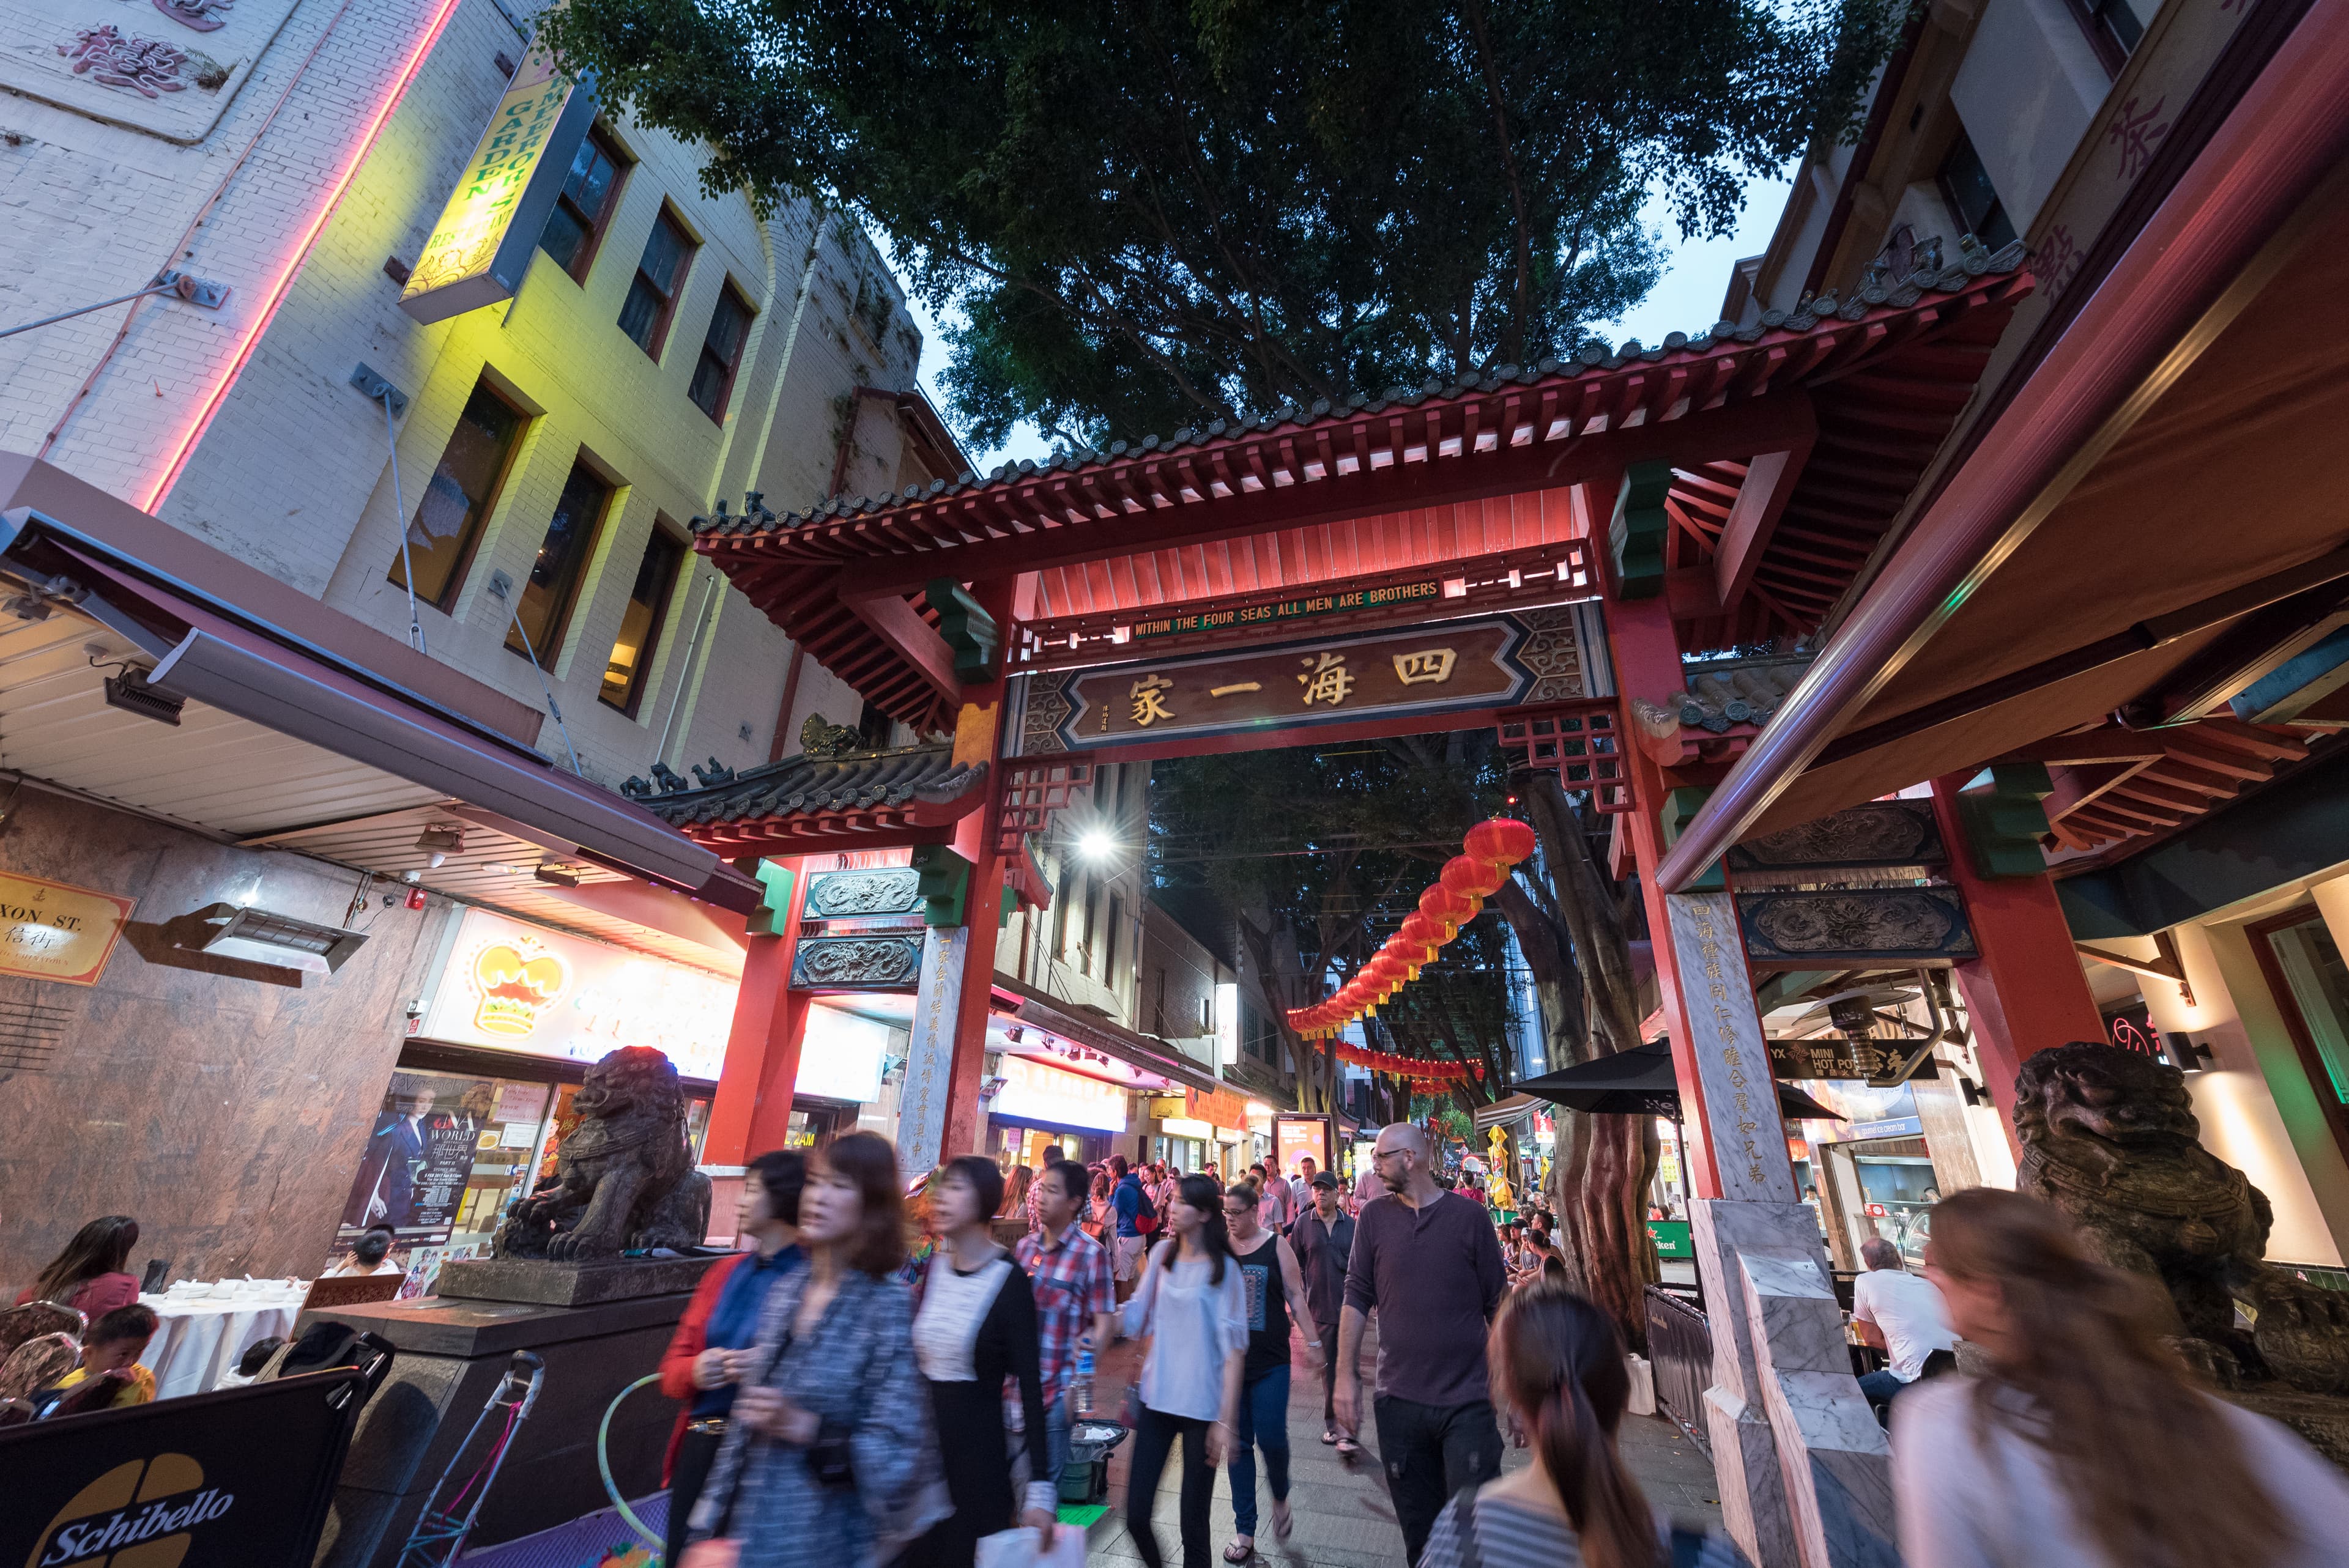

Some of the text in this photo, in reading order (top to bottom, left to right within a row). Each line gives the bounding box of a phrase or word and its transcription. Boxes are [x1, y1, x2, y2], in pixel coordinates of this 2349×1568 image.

[463, 99, 534, 201] GARDEN
[429, 208, 514, 250] RESANT
[1135, 582, 1437, 637] WITHIN THE FOUR SEAS ALL MEN ARE BROTHERS
[53, 914, 81, 931] ST.
[1770, 1048, 1834, 1059] YX MINI
[1813, 1059, 1855, 1069] HOT POT
[1883, 1124, 1898, 1133] cream
[1898, 1122, 1906, 1131] bar
[431, 1130, 475, 1142] WORLD
[793, 1133, 815, 1147] 2AM
[40, 1487, 235, 1567] Schibello
